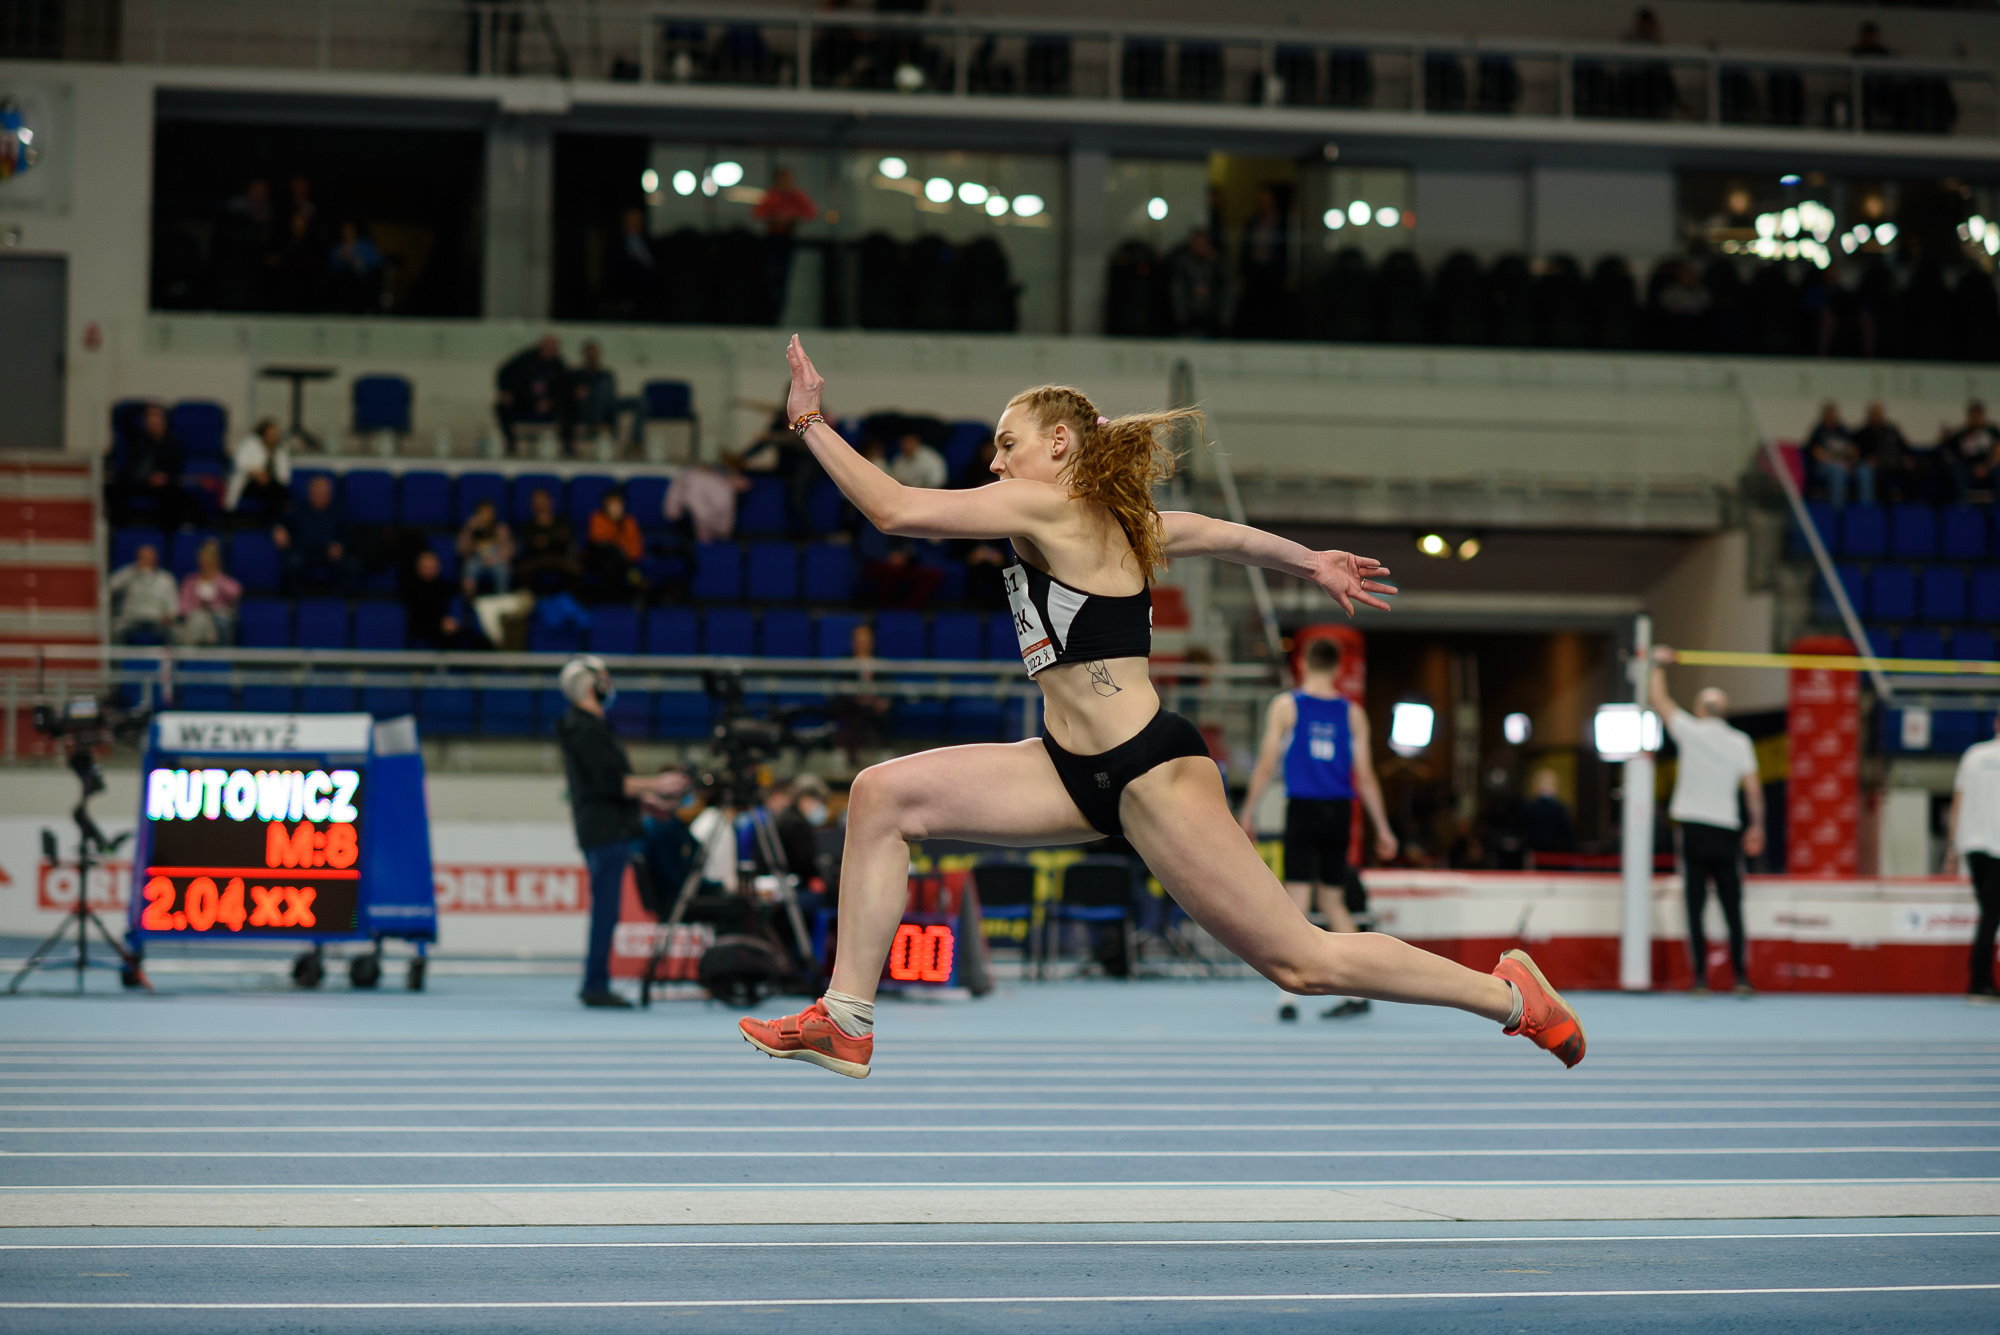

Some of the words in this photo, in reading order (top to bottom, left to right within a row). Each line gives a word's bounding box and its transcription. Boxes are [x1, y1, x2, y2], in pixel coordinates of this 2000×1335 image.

[147, 768, 360, 822] RUTOWICZ
[266, 821, 359, 869] M:8
[141, 876, 247, 932] 2.04
[889, 924, 955, 982] 00
